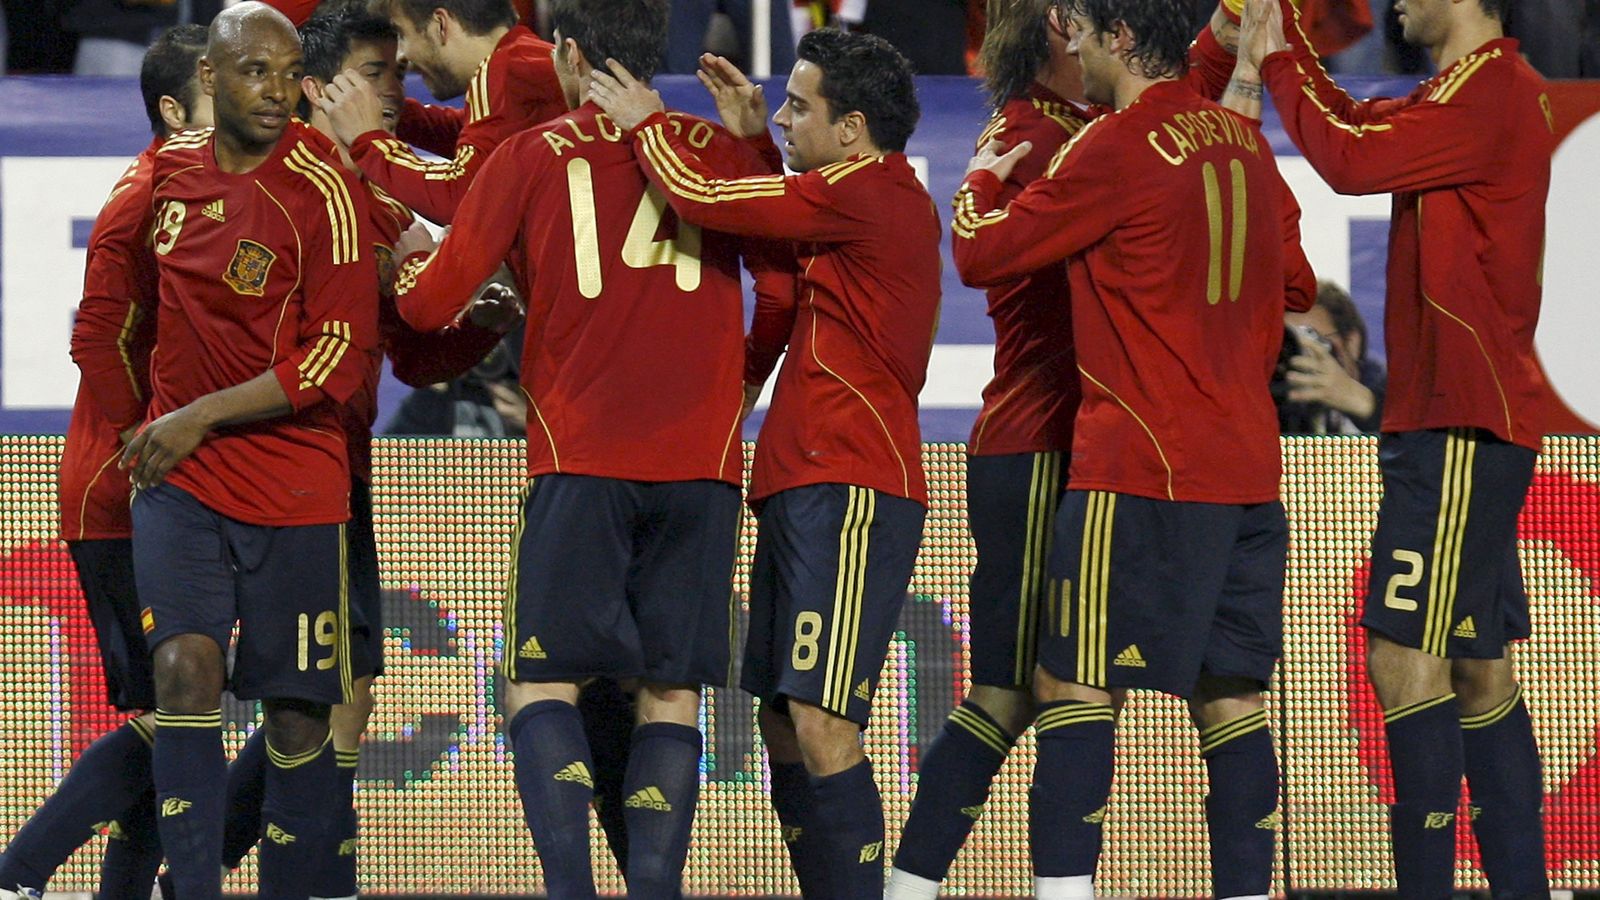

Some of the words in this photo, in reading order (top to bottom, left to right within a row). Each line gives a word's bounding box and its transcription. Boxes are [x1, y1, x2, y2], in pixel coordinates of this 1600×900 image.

[542, 111, 714, 156] ALOSO
[1147, 110, 1261, 166] CAPDEVILA
[567, 157, 702, 299] 14
[1202, 158, 1248, 305] 11
[1384, 548, 1424, 612] 2
[298, 610, 339, 671] 19
[791, 611, 823, 671] 8
[624, 799, 673, 812] adidas
